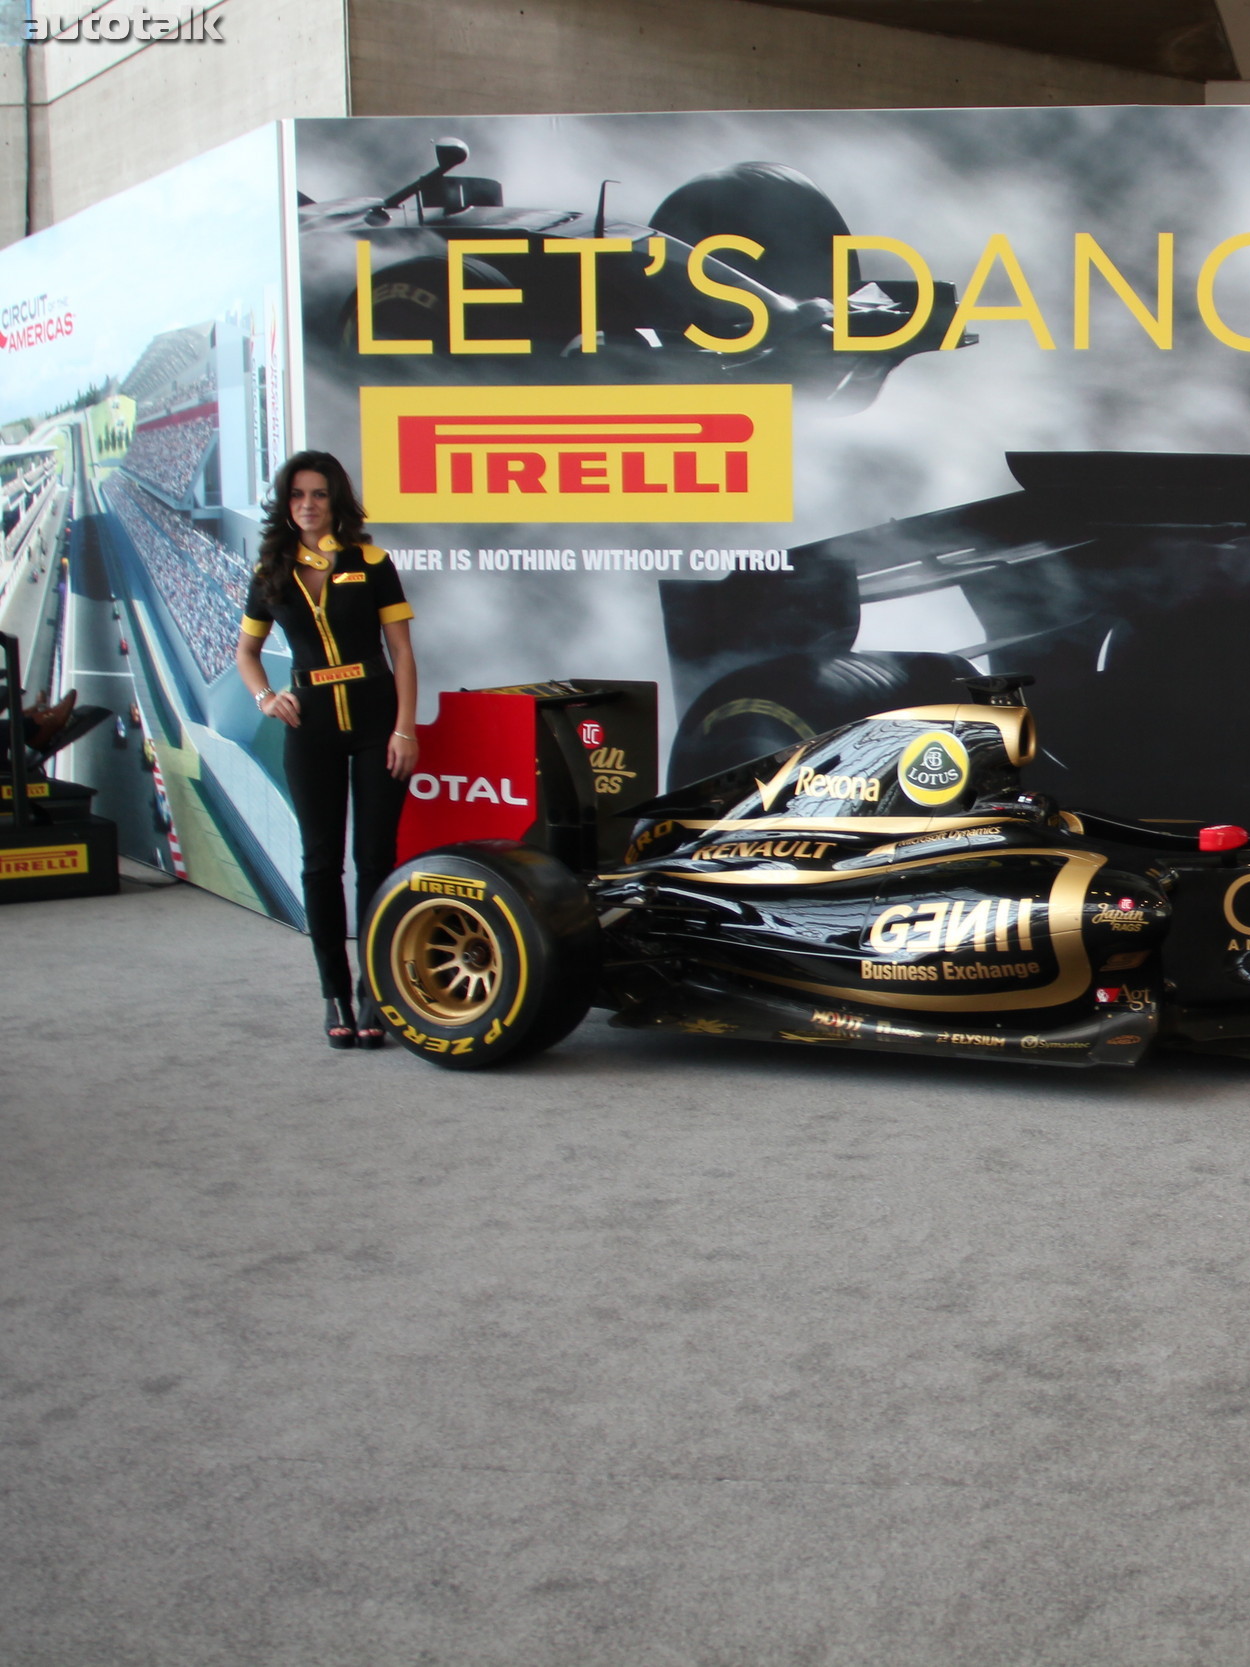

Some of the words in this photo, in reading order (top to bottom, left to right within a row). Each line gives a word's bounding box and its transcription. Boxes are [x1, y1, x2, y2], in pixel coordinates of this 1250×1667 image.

[356, 233, 769, 355] LET'S
[2, 294, 47, 330] CIRCUIT
[8, 312, 74, 354] AMERICAS
[398, 413, 754, 494] PIRELLI
[450, 549, 471, 570] IS
[479, 549, 576, 570] NOTHING
[583, 549, 682, 570] WITHOUT
[689, 549, 794, 571] CONTROL
[794, 766, 881, 802] Rexona
[908, 767, 959, 786] LOTUS
[408, 774, 528, 806] OTAL
[949, 826, 1002, 841] Dynamics
[692, 840, 836, 861] RENAULT
[409, 871, 487, 901] PIRELLI
[1092, 902, 1146, 924] Japan
[1112, 923, 1142, 932] RAGS
[861, 961, 938, 981] Business
[942, 961, 1041, 981] Exchange
[380, 1004, 475, 1056] ZERO
[484, 1018, 503, 1045] P
[951, 1033, 1006, 1047] ELYSIUM
[1039, 1039, 1091, 1048] Symantec
